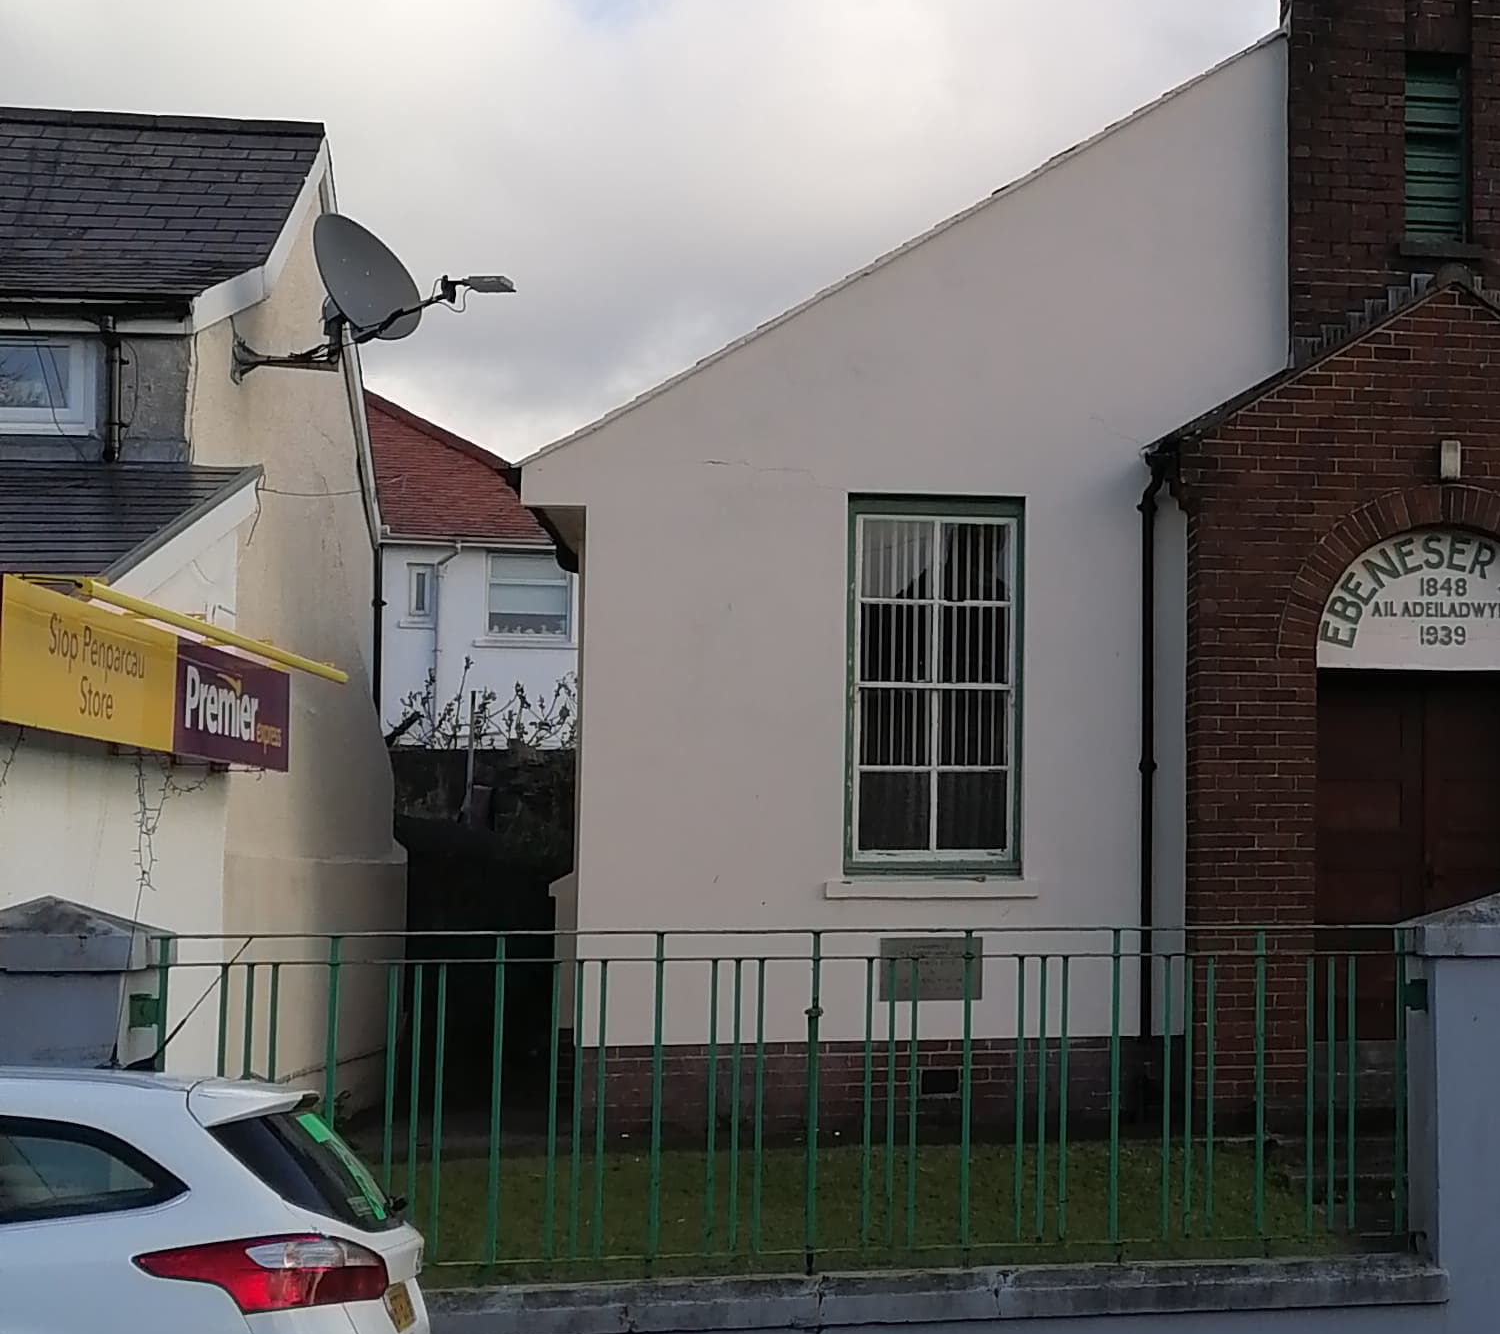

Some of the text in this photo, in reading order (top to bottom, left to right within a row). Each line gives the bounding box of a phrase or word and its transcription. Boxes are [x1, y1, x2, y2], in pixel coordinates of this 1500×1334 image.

[1320, 534, 1496, 648] EBENESER
[1371, 600, 1398, 617] AIL
[1419, 577, 1467, 597] 1848
[49, 612, 146, 683] Siop Penparcau
[1420, 625, 1466, 646] 1939
[79, 675, 114, 720] Store
[185, 665, 259, 741] Premier
